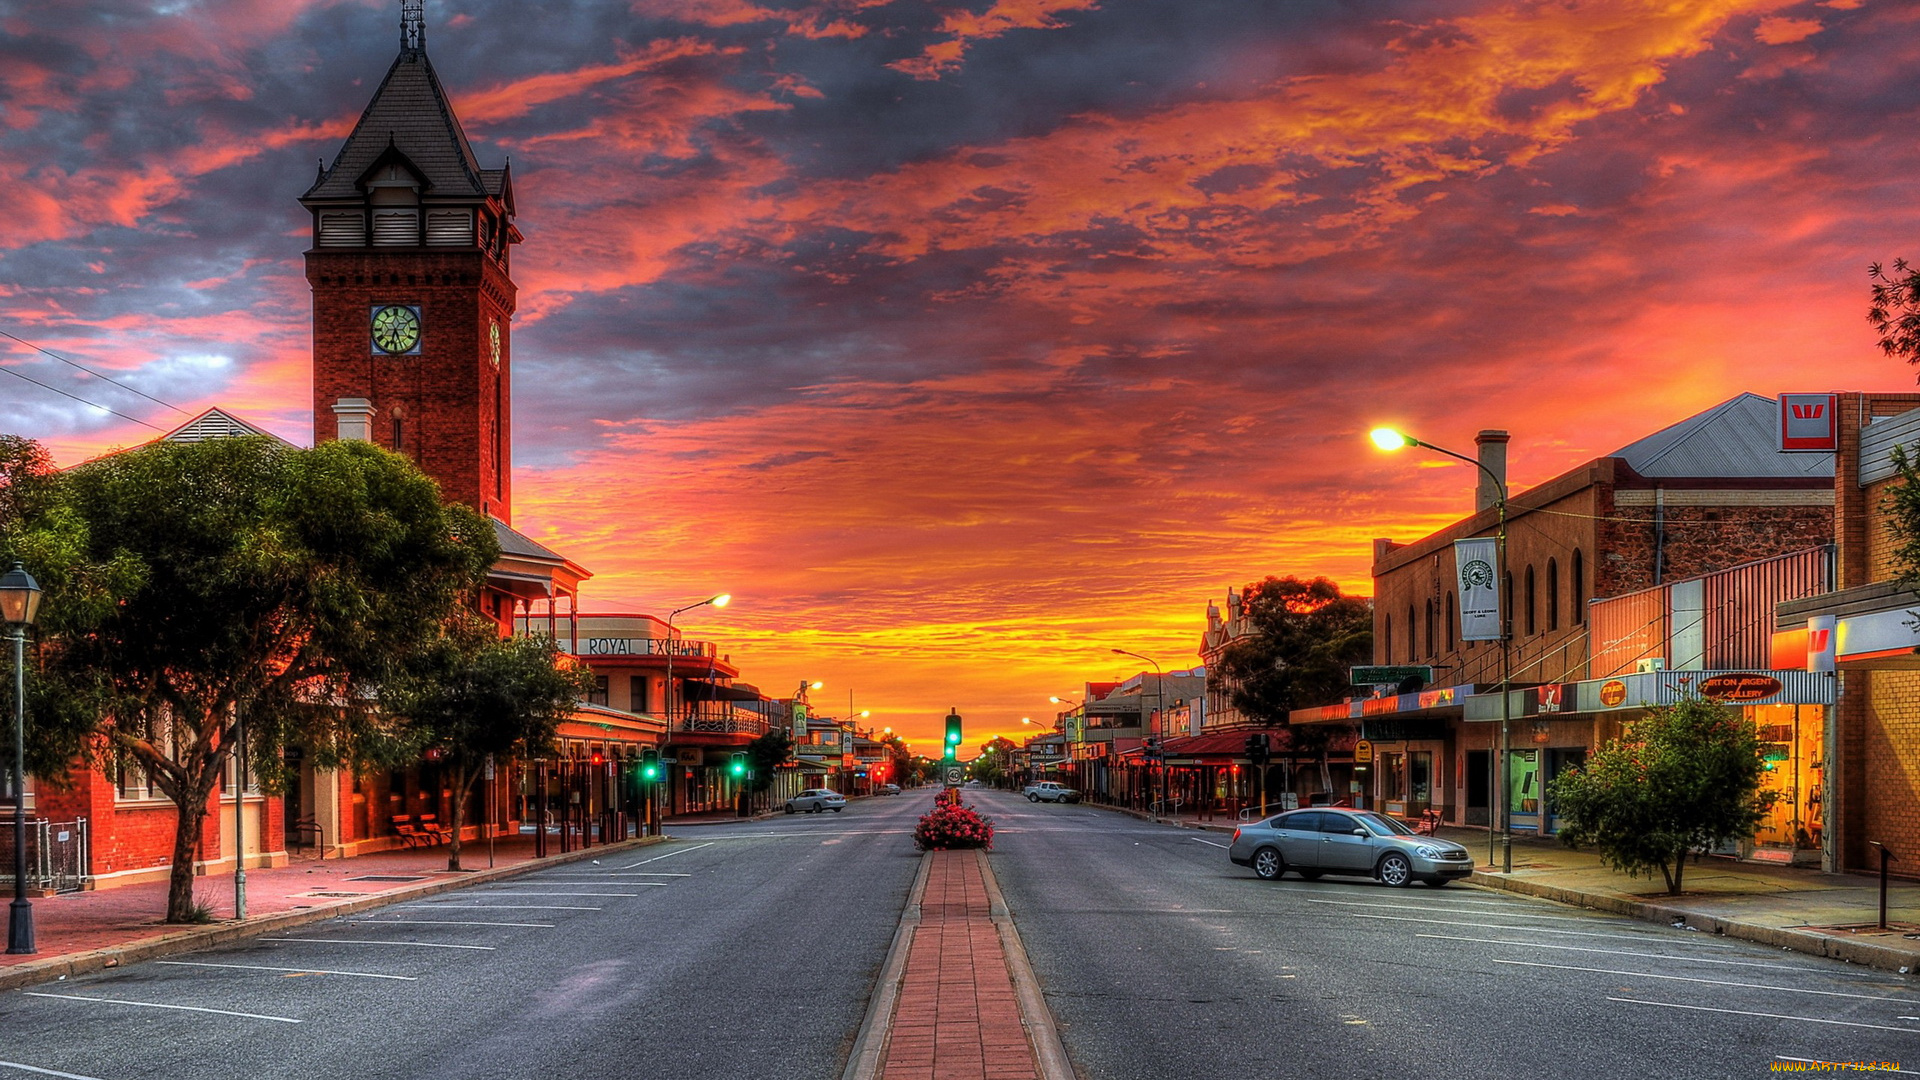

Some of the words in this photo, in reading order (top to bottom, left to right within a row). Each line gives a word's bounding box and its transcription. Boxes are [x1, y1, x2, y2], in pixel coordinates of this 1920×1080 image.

[589, 639, 635, 655] ROYAL
[1706, 679, 1722, 687] ART
[1738, 678, 1773, 686] ARGENT
[1727, 690, 1763, 698] GALLERY
